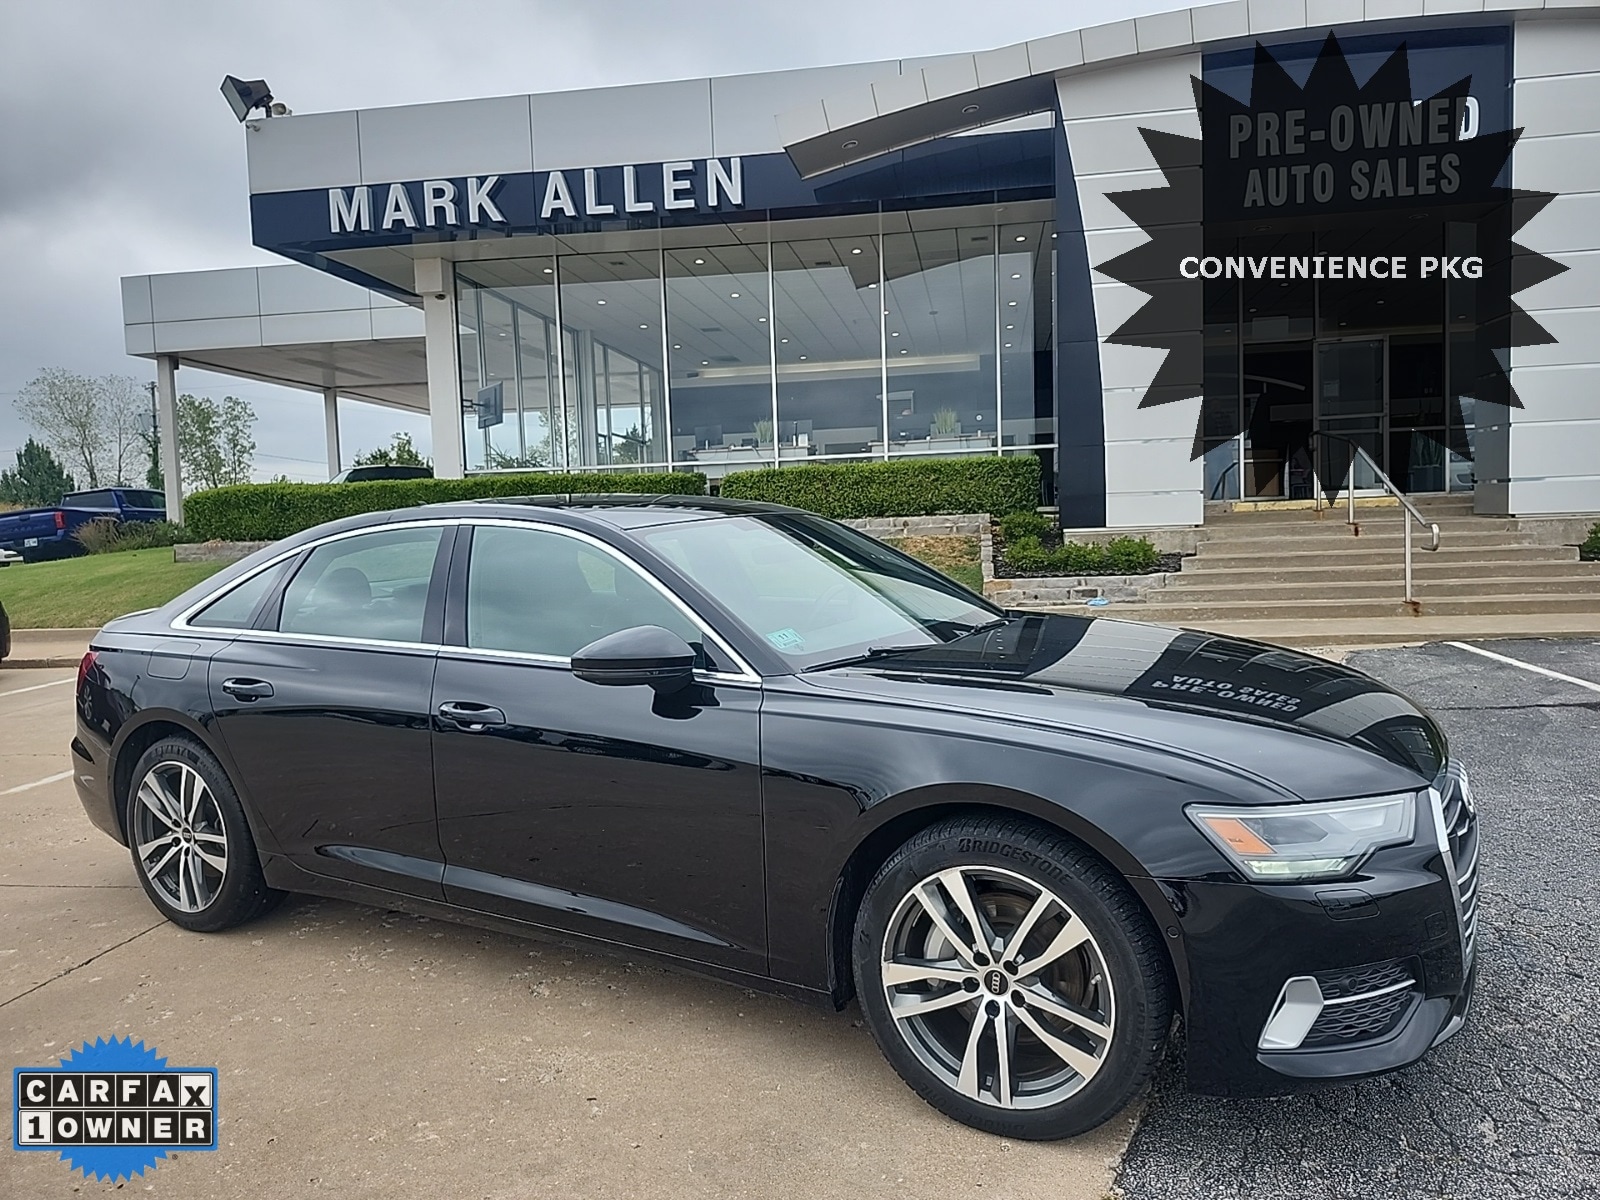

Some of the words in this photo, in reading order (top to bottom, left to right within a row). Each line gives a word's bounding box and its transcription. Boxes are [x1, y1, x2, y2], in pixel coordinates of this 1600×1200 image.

[1230, 96, 1480, 159] PRE-OWNED
[328, 175, 506, 234] MARK
[540, 157, 744, 219] ALLEN
[1243, 162, 1335, 208] AUTO
[1351, 153, 1461, 201] SALES
[958, 838, 1073, 885] BRIDGESTONE
